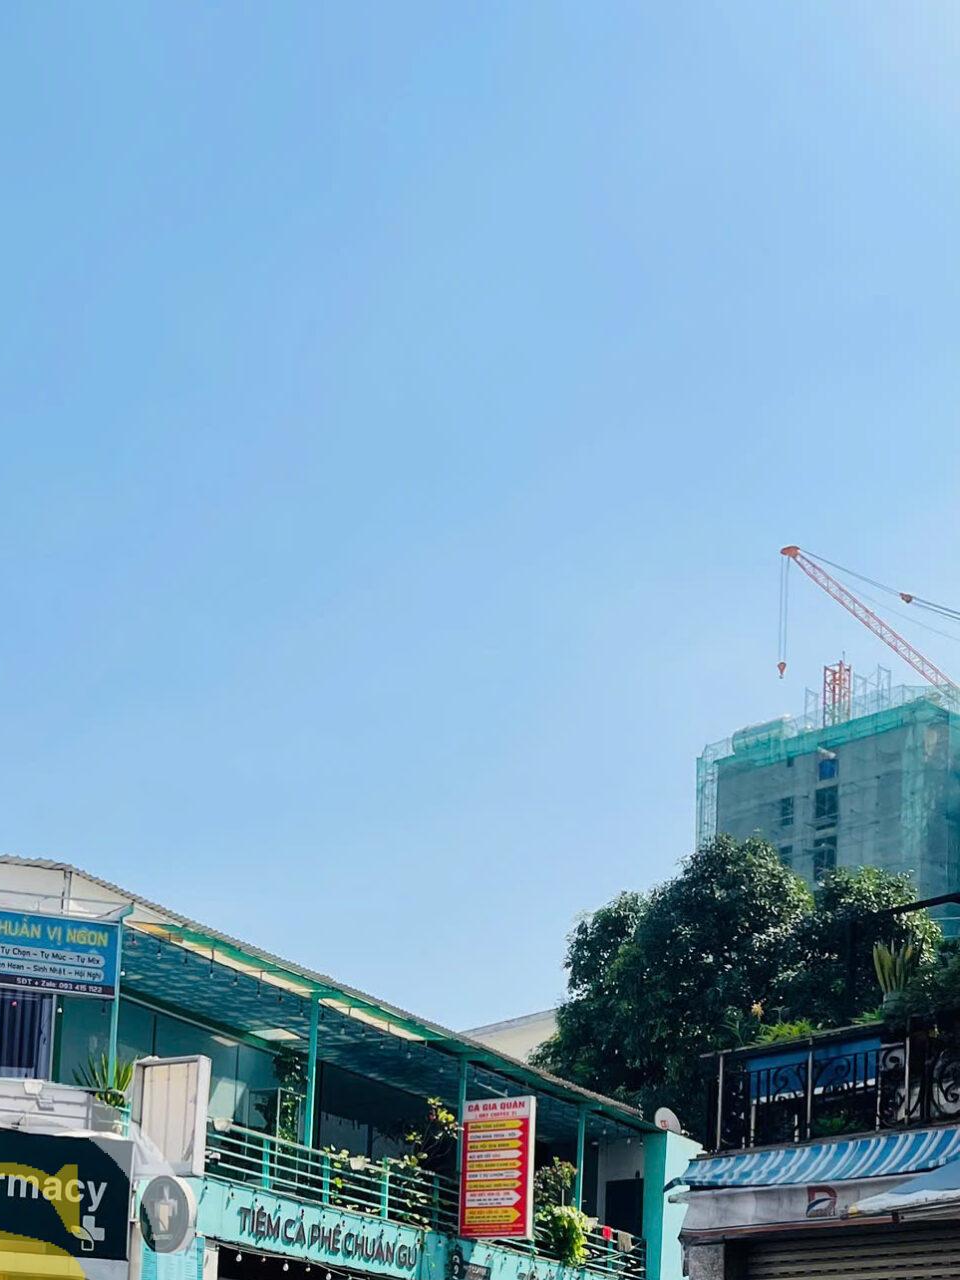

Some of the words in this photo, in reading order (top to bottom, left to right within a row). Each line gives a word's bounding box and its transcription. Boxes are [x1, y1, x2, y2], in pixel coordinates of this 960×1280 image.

[47, 926, 63, 945] VỊ
[66, 927, 109, 948] NGON
[33, 964, 48, 974] Sinh
[482, 1102, 497, 1111] GIA
[237, 1204, 281, 1245] TIỆM
[308, 1221, 342, 1251] PHÊ
[396, 1243, 419, 1271] GU
